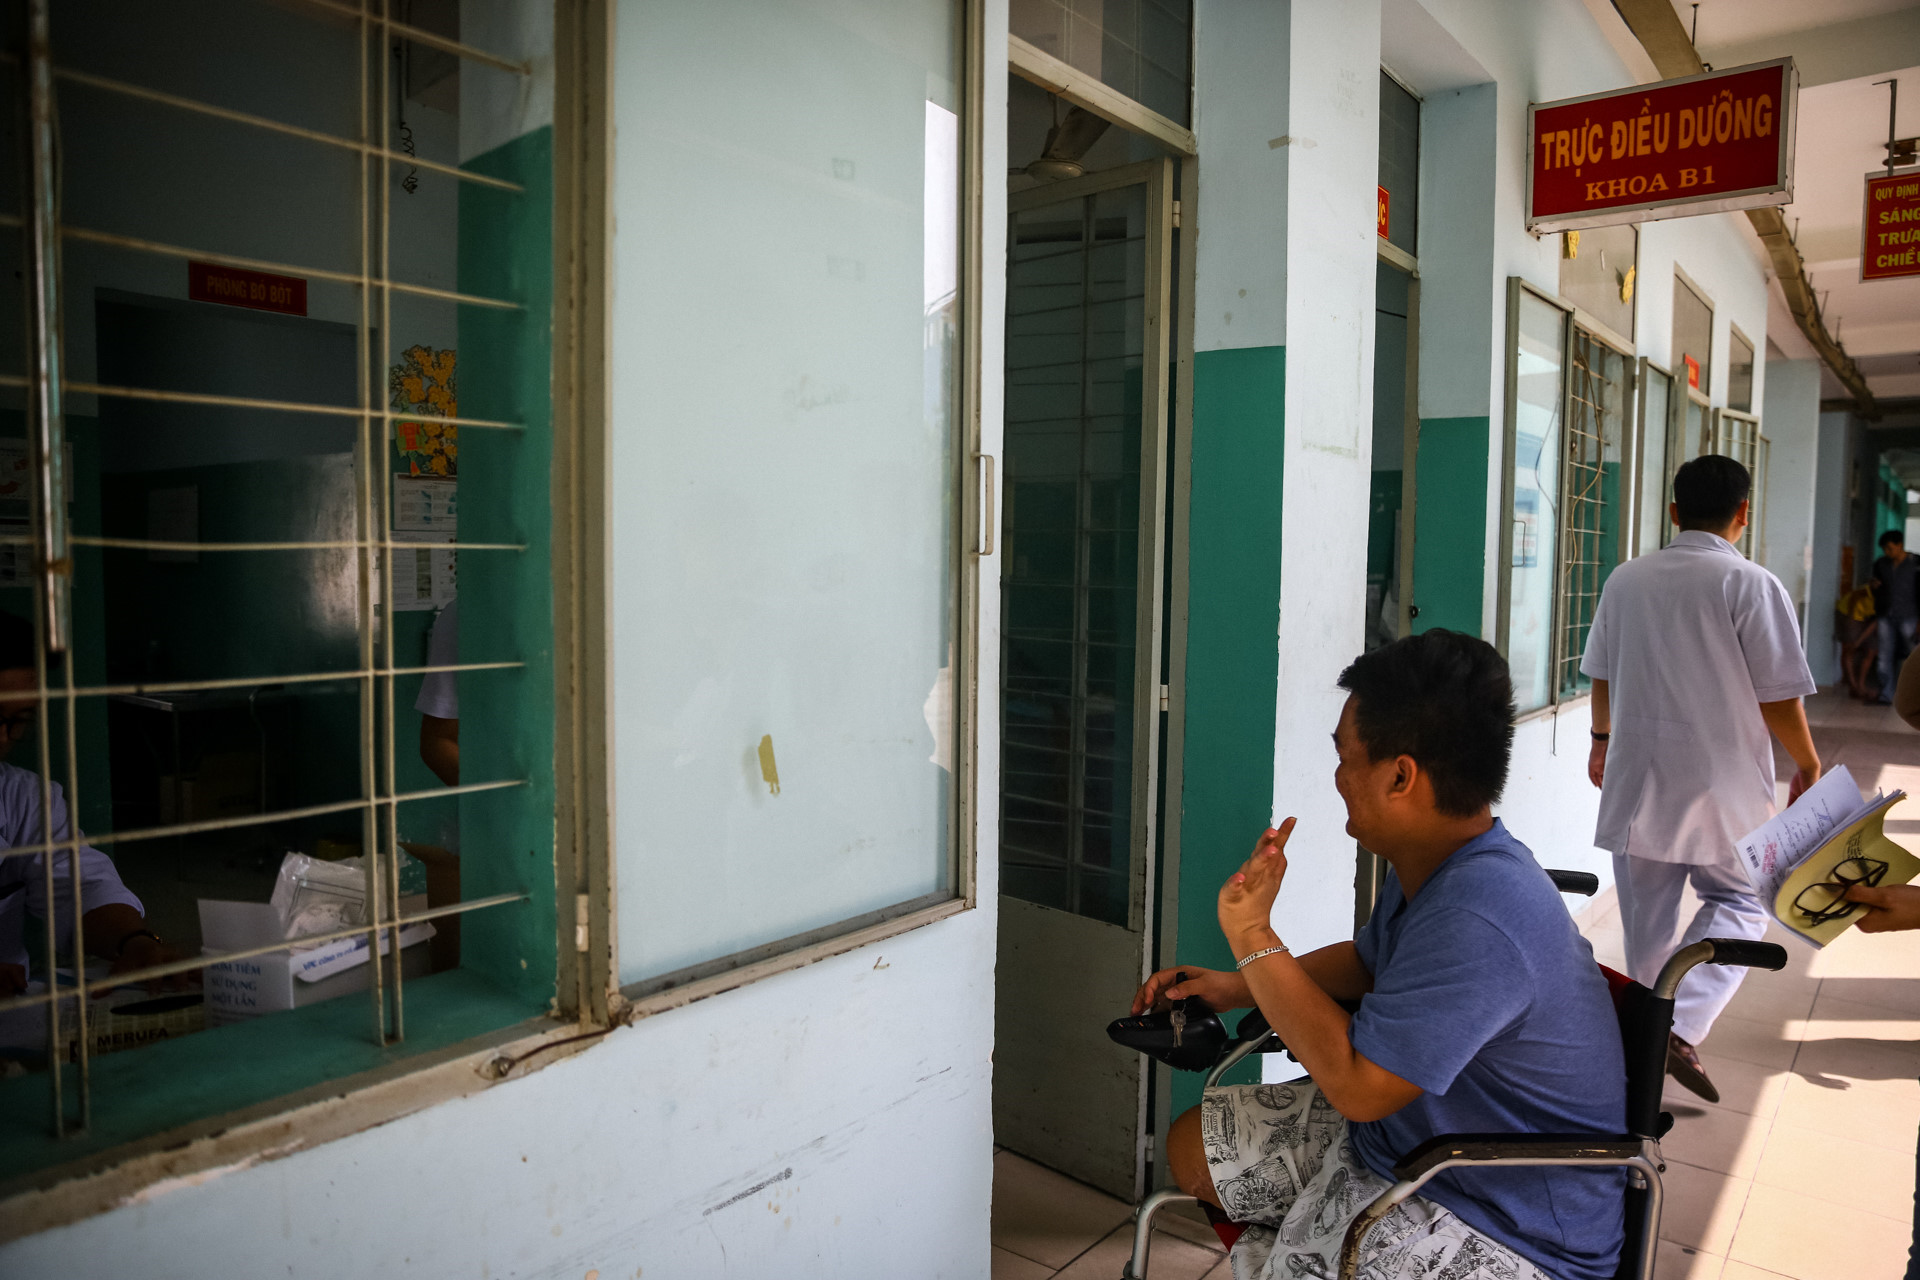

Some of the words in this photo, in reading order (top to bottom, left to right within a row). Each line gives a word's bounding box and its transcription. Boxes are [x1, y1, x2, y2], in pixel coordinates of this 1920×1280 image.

[1541, 117, 1604, 178] TRỰC
[1611, 98, 1671, 160] ĐIỀU
[1678, 89, 1773, 150] DƯỠNG
[1585, 173, 1669, 201] KHOA
[1678, 165, 1716, 188] B1
[1875, 186, 1894, 202] QUY
[1896, 184, 1919, 200] ĐỊNH
[1878, 227, 1920, 246] TRƯA
[206, 273, 248, 300] PHÒNG
[249, 279, 267, 302] BÓ
[269, 282, 293, 308] BỘT
[97, 1027, 169, 1047] MERUFA
[1363, 1221, 1382, 1251] CLOTHES
